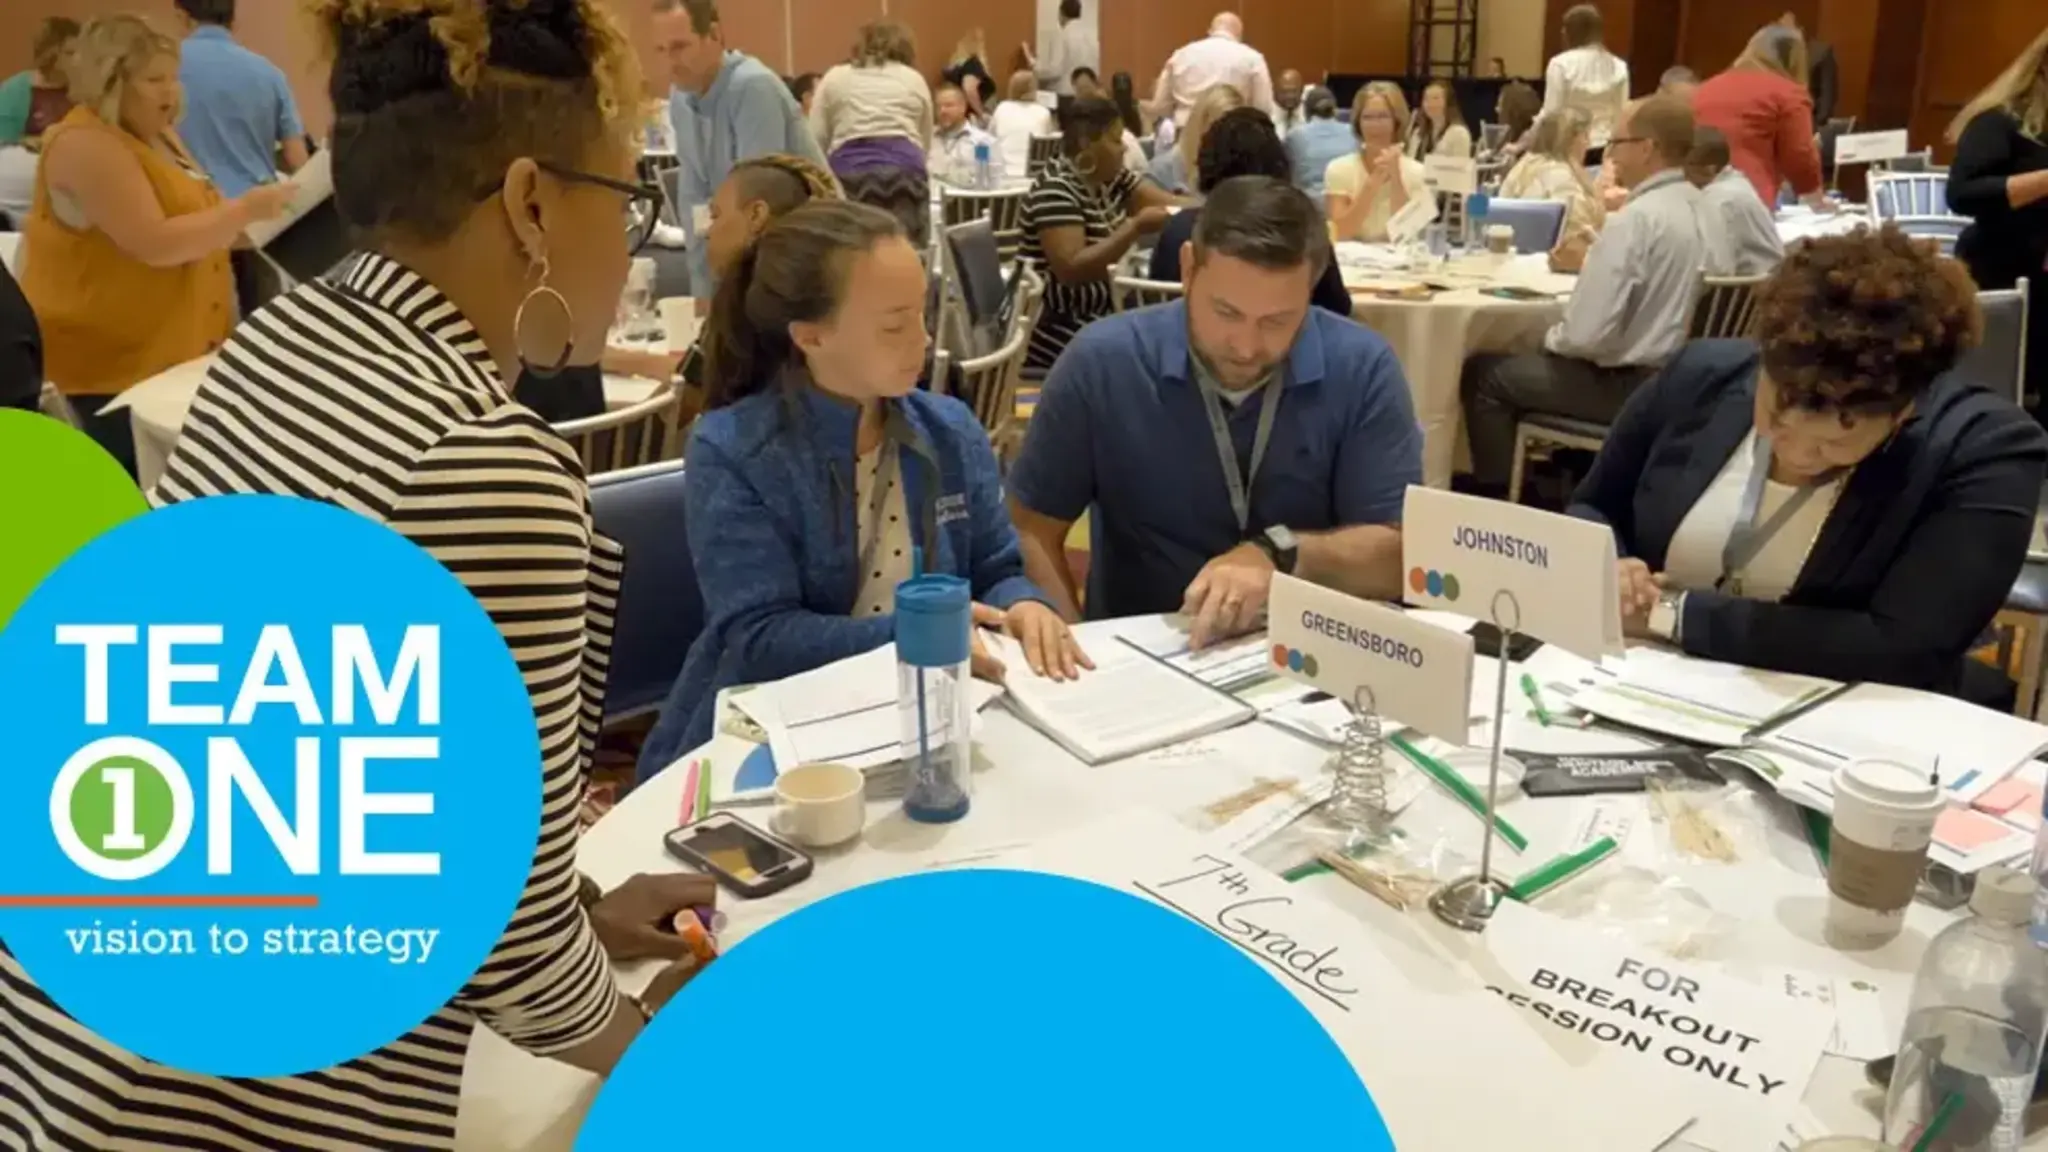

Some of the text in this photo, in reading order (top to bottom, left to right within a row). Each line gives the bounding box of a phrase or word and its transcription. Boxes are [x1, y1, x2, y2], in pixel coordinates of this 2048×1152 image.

[1453, 525, 1548, 569] JOHNSTON
[1301, 610, 1423, 668] GREENSBORO
[1156, 854, 1360, 995] 7th Grade
[1615, 957, 1701, 1003] FOR
[1530, 968, 1761, 1053] BREAKOUT
[1663, 1045, 1787, 1096] ONLY
